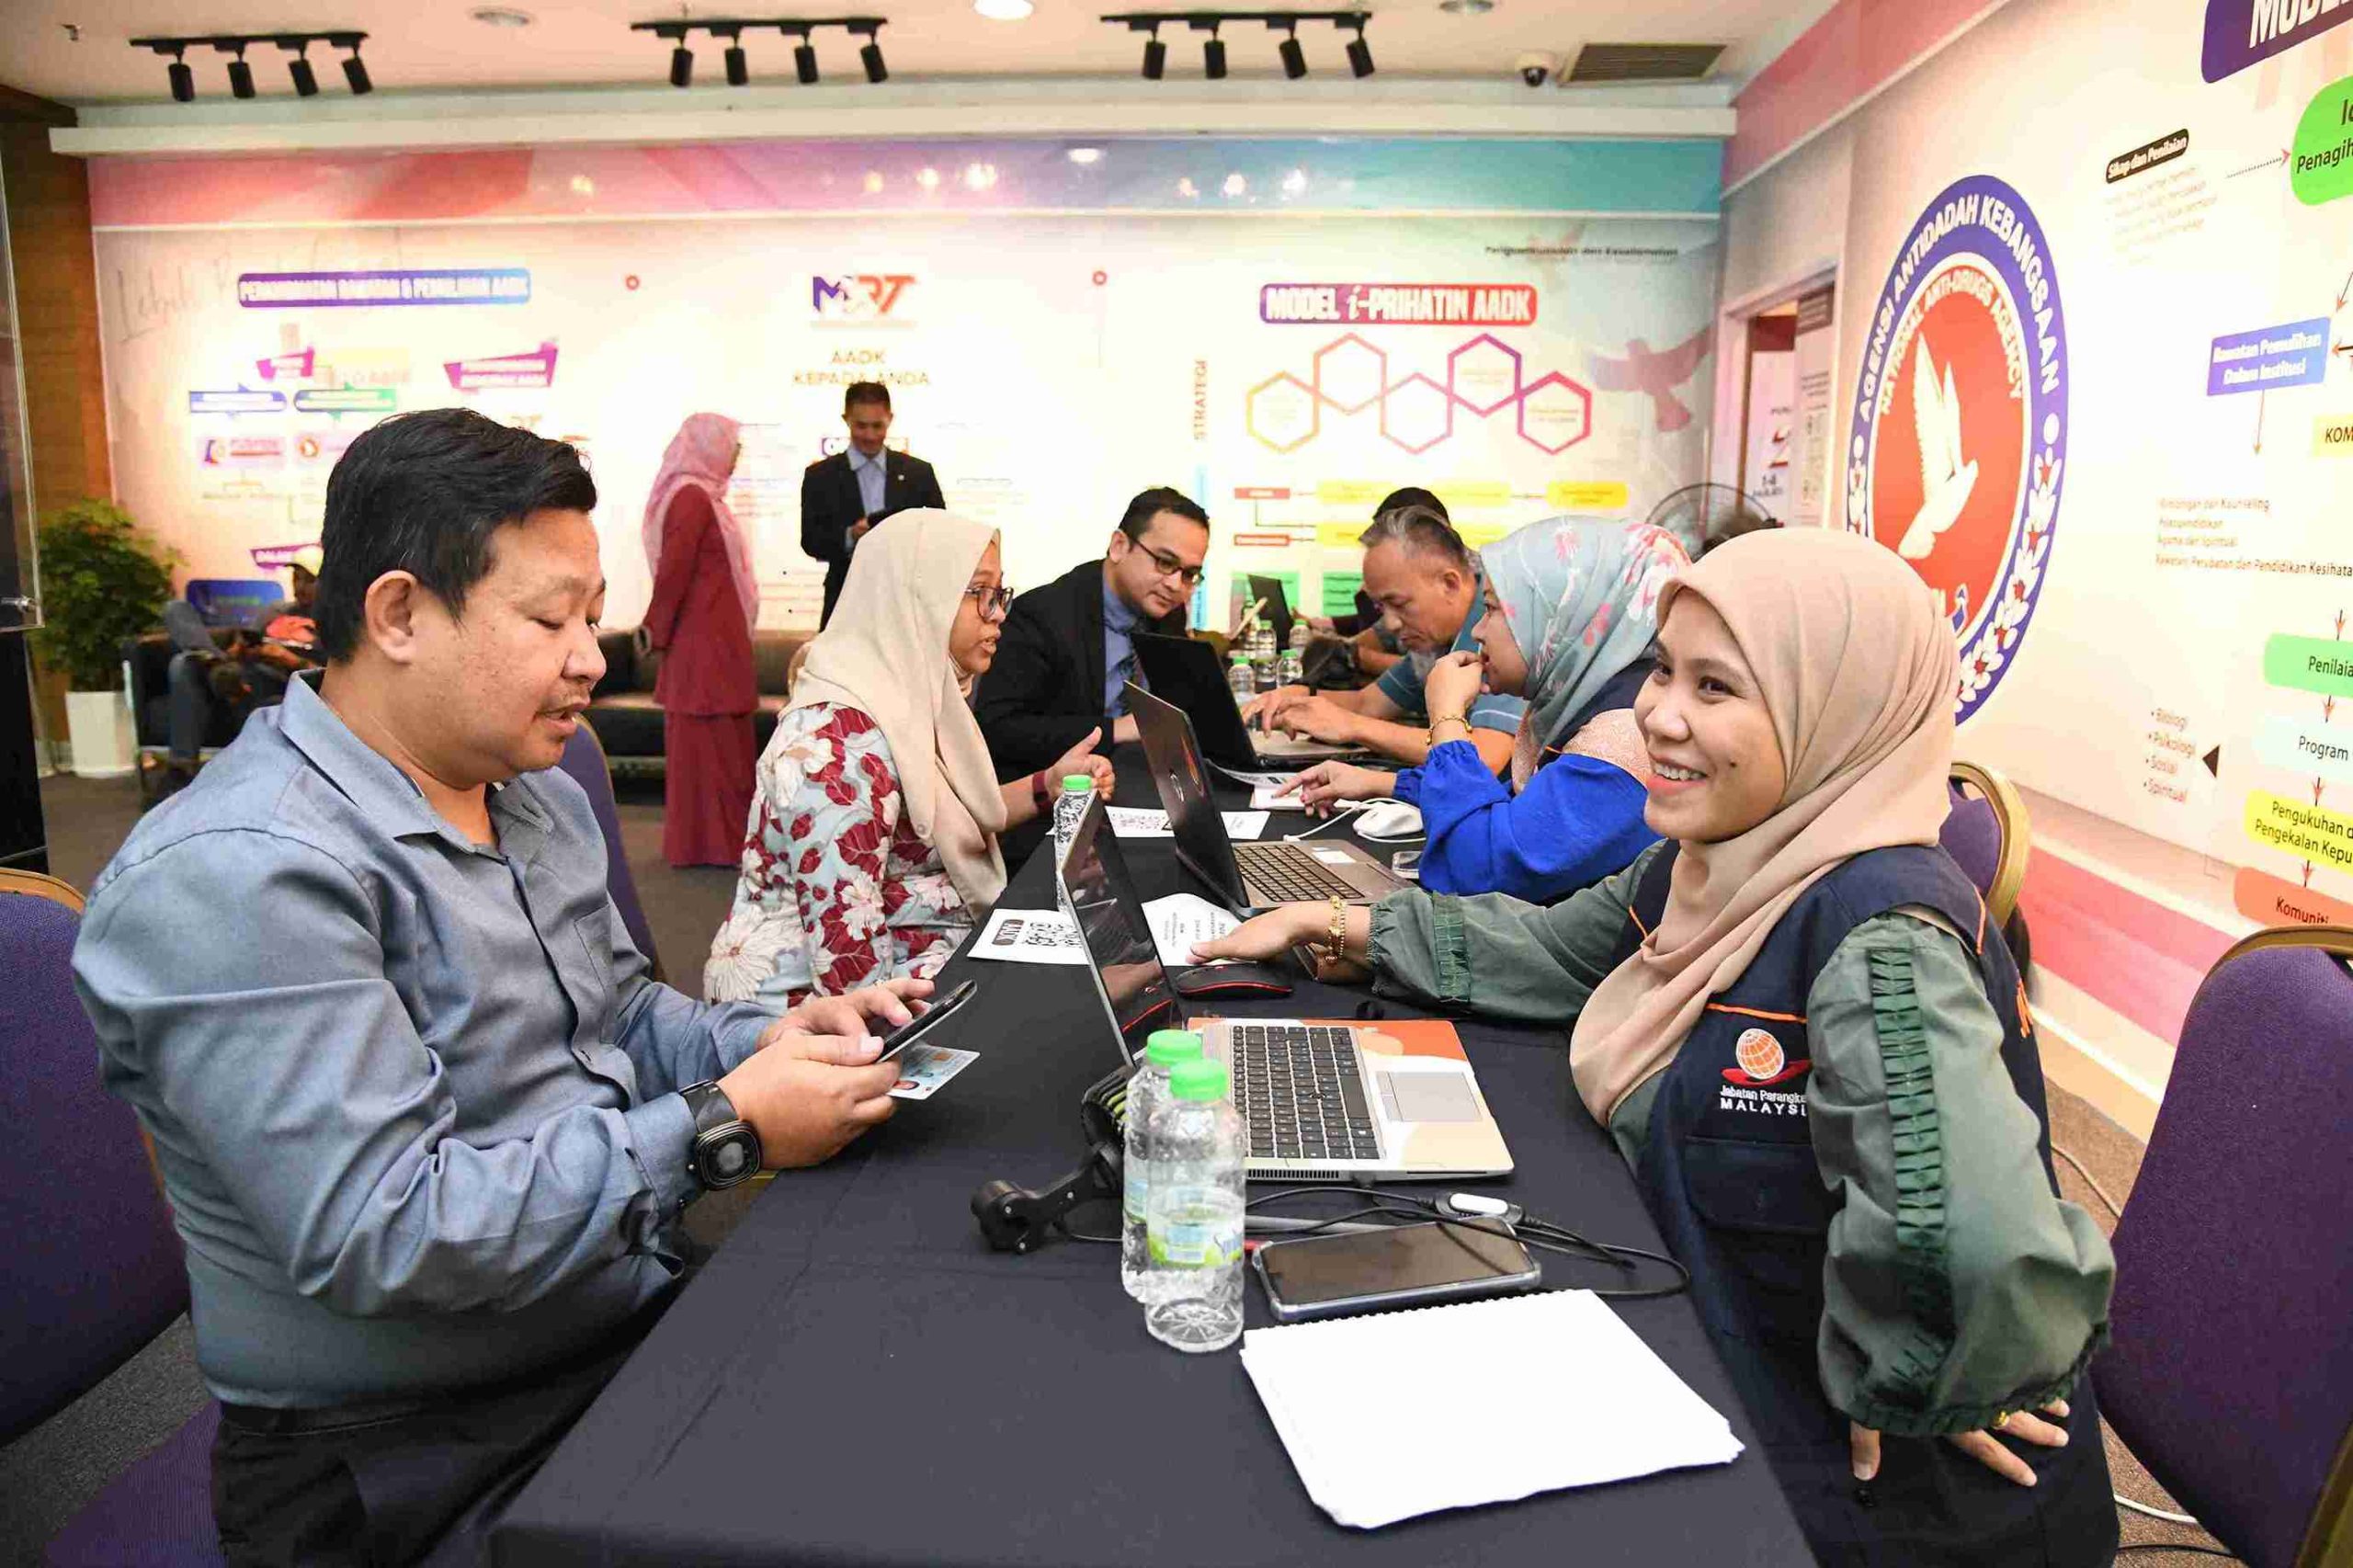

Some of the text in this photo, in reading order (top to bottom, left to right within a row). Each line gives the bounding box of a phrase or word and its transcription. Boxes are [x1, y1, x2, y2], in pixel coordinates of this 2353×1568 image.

[2297, 137, 2353, 174] Penagih
[1266, 285, 1533, 322] MODEL i-PRIHATIN AADK
[1859, 297, 1895, 422] AGENSI
[1893, 194, 1980, 303] ANTIDADAH
[1979, 194, 2060, 395] KEBANGSAAN
[2255, 558, 2306, 574] Pendidikan
[2310, 561, 2353, 577] Kesihata
[2308, 655, 2353, 677] Penilaia
[2299, 735, 2348, 761] Program
[2272, 801, 2344, 836] Pengukuhan
[2255, 818, 2353, 864] Pengekalan Kepu
[1720, 1085, 1757, 1100] Jabatan
[1720, 1097, 1807, 1117] MALAYSI
